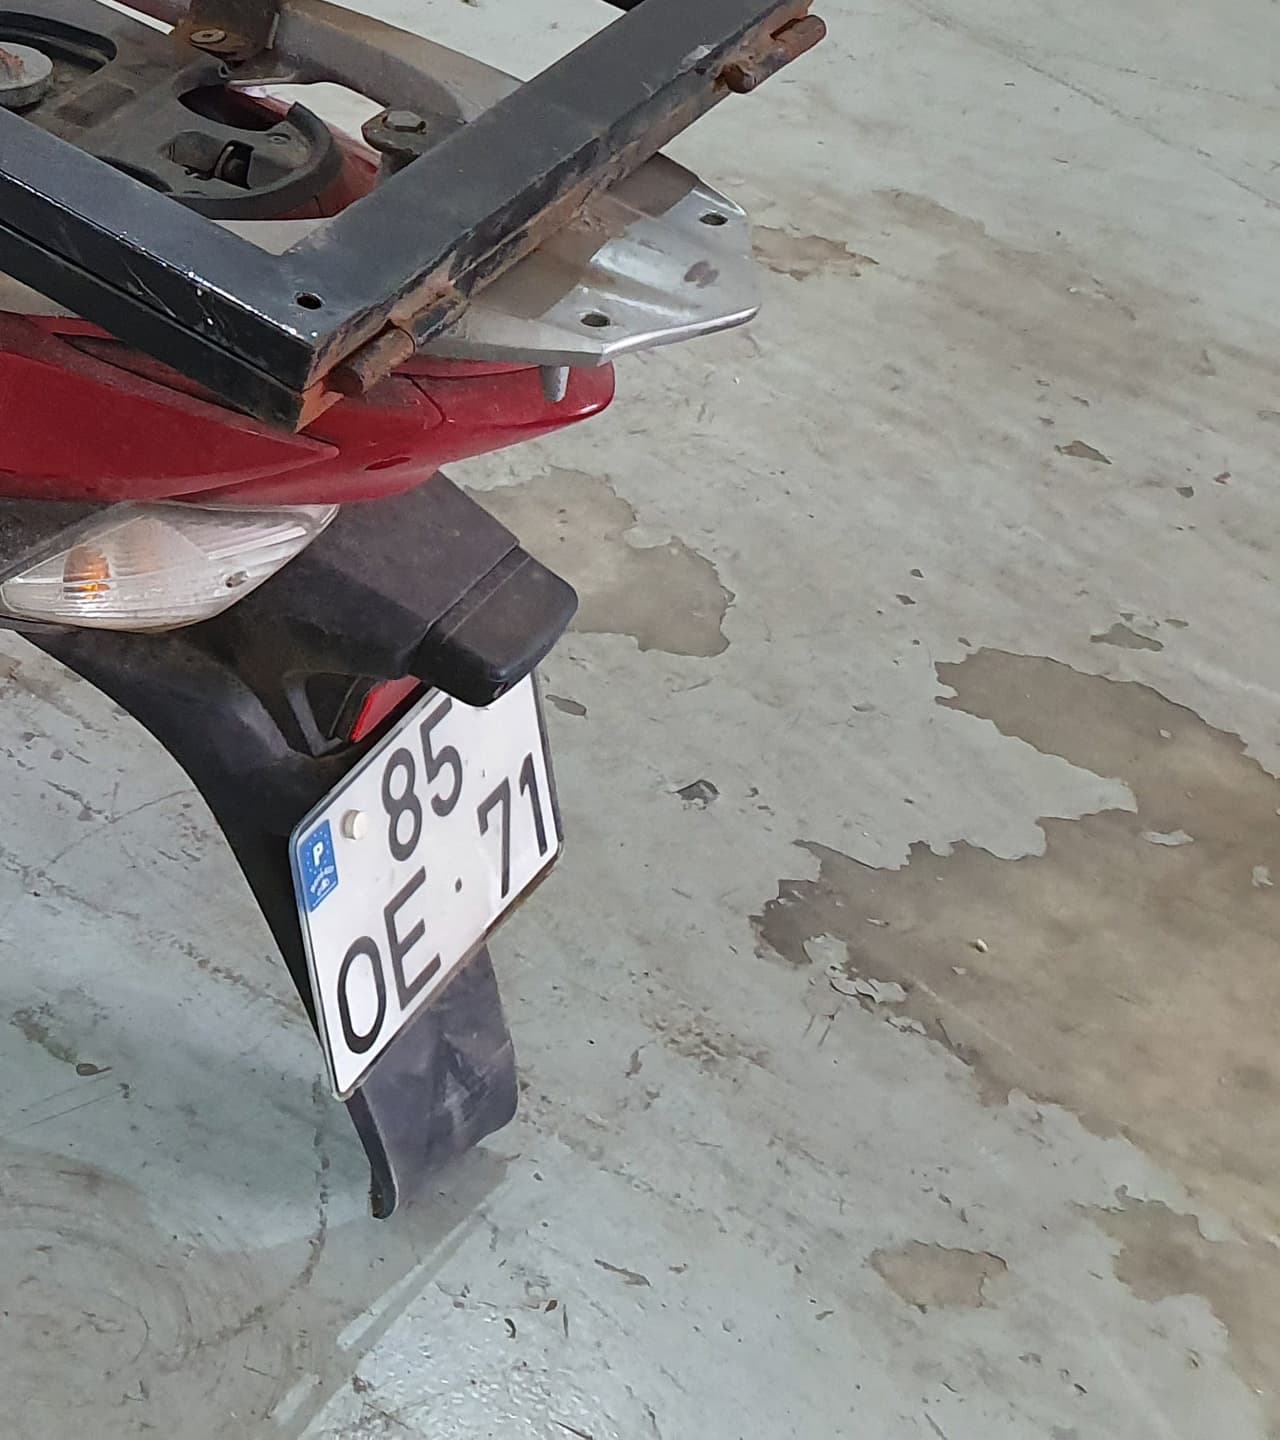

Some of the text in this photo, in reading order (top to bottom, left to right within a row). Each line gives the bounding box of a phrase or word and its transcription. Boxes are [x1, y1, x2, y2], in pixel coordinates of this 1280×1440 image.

[312, 841, 324, 867] P
[381, 697, 463, 862] 85
[336, 752, 548, 1055] OE 71
